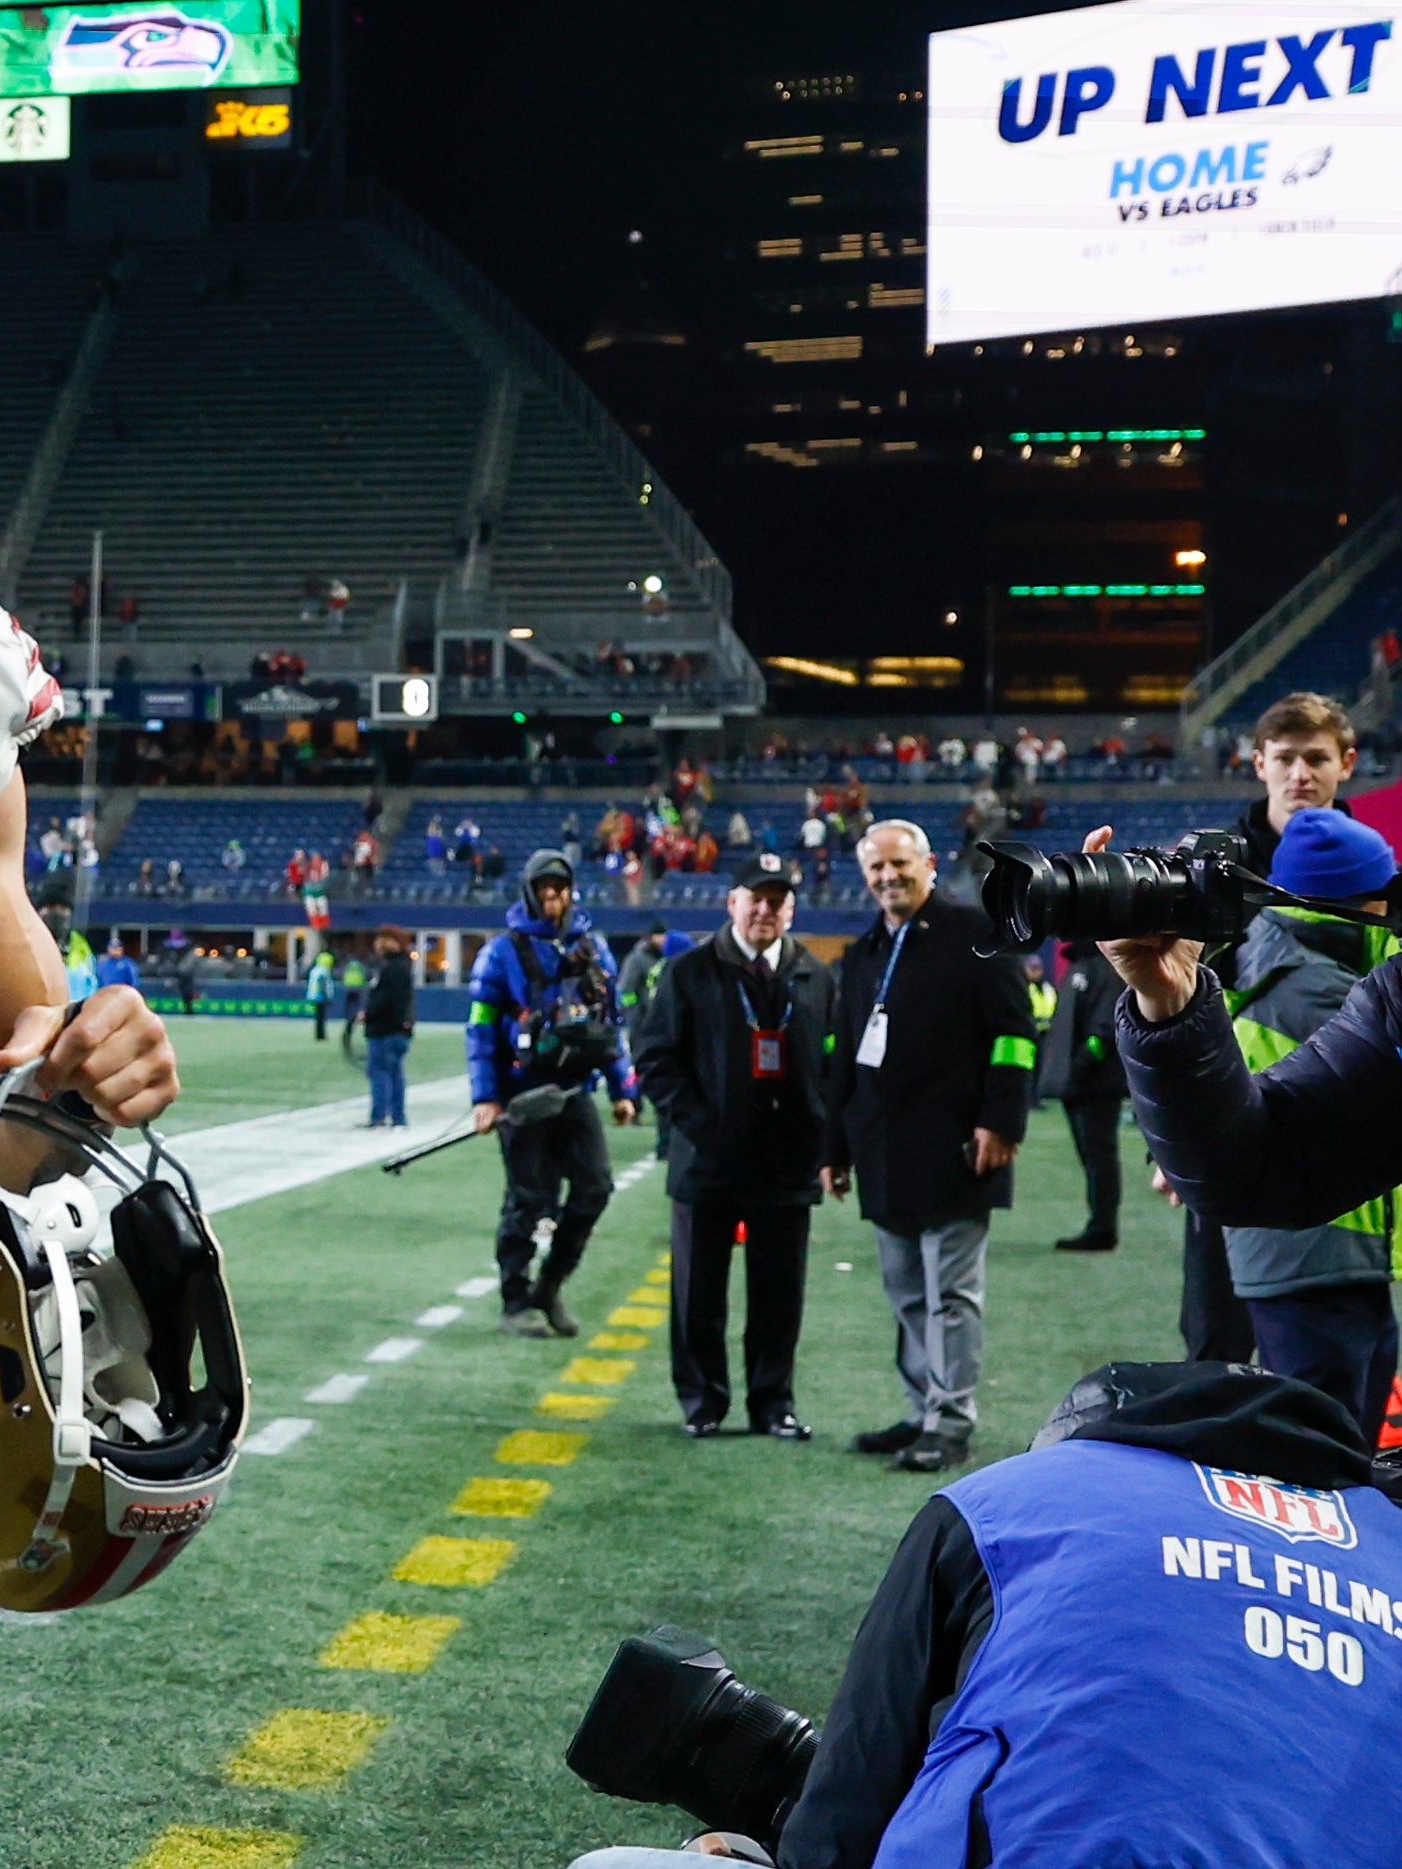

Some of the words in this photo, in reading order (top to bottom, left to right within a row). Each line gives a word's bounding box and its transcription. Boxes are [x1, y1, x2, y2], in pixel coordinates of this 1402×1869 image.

[998, 66, 1115, 143] UP
[1145, 20, 1393, 124] NEXT
[1110, 141, 1270, 199] HOME
[1119, 200, 1149, 223] VS
[1161, 188, 1258, 218] EAGLES
[1221, 1479, 1338, 1537] NFL
[1161, 1536, 1266, 1590] NFL
[1244, 1606, 1364, 1687] 050
